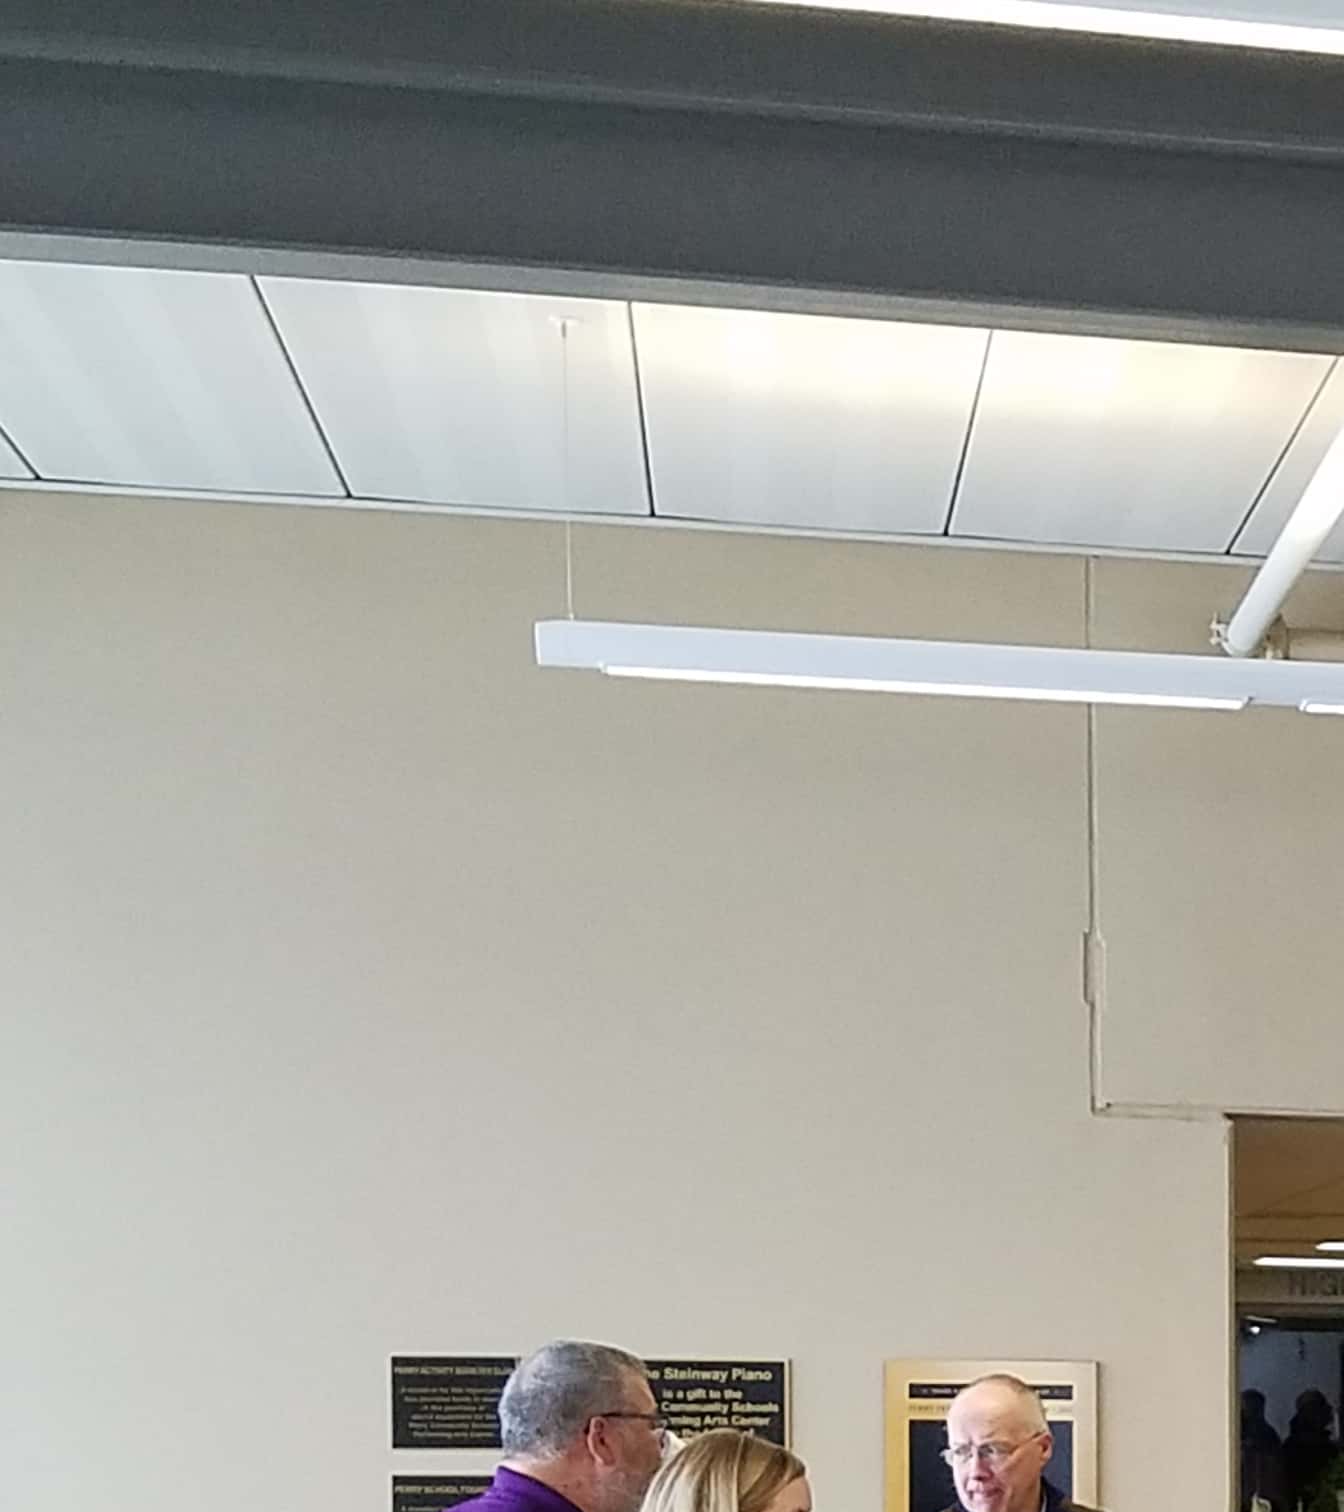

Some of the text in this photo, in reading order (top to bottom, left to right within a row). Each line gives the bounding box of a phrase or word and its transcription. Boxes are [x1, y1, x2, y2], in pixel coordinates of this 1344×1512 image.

[664, 1366, 729, 1383] Steinway
[732, 1367, 773, 1381] Piano
[732, 1402, 779, 1413] Schools
[703, 1416, 729, 1426] Arts
